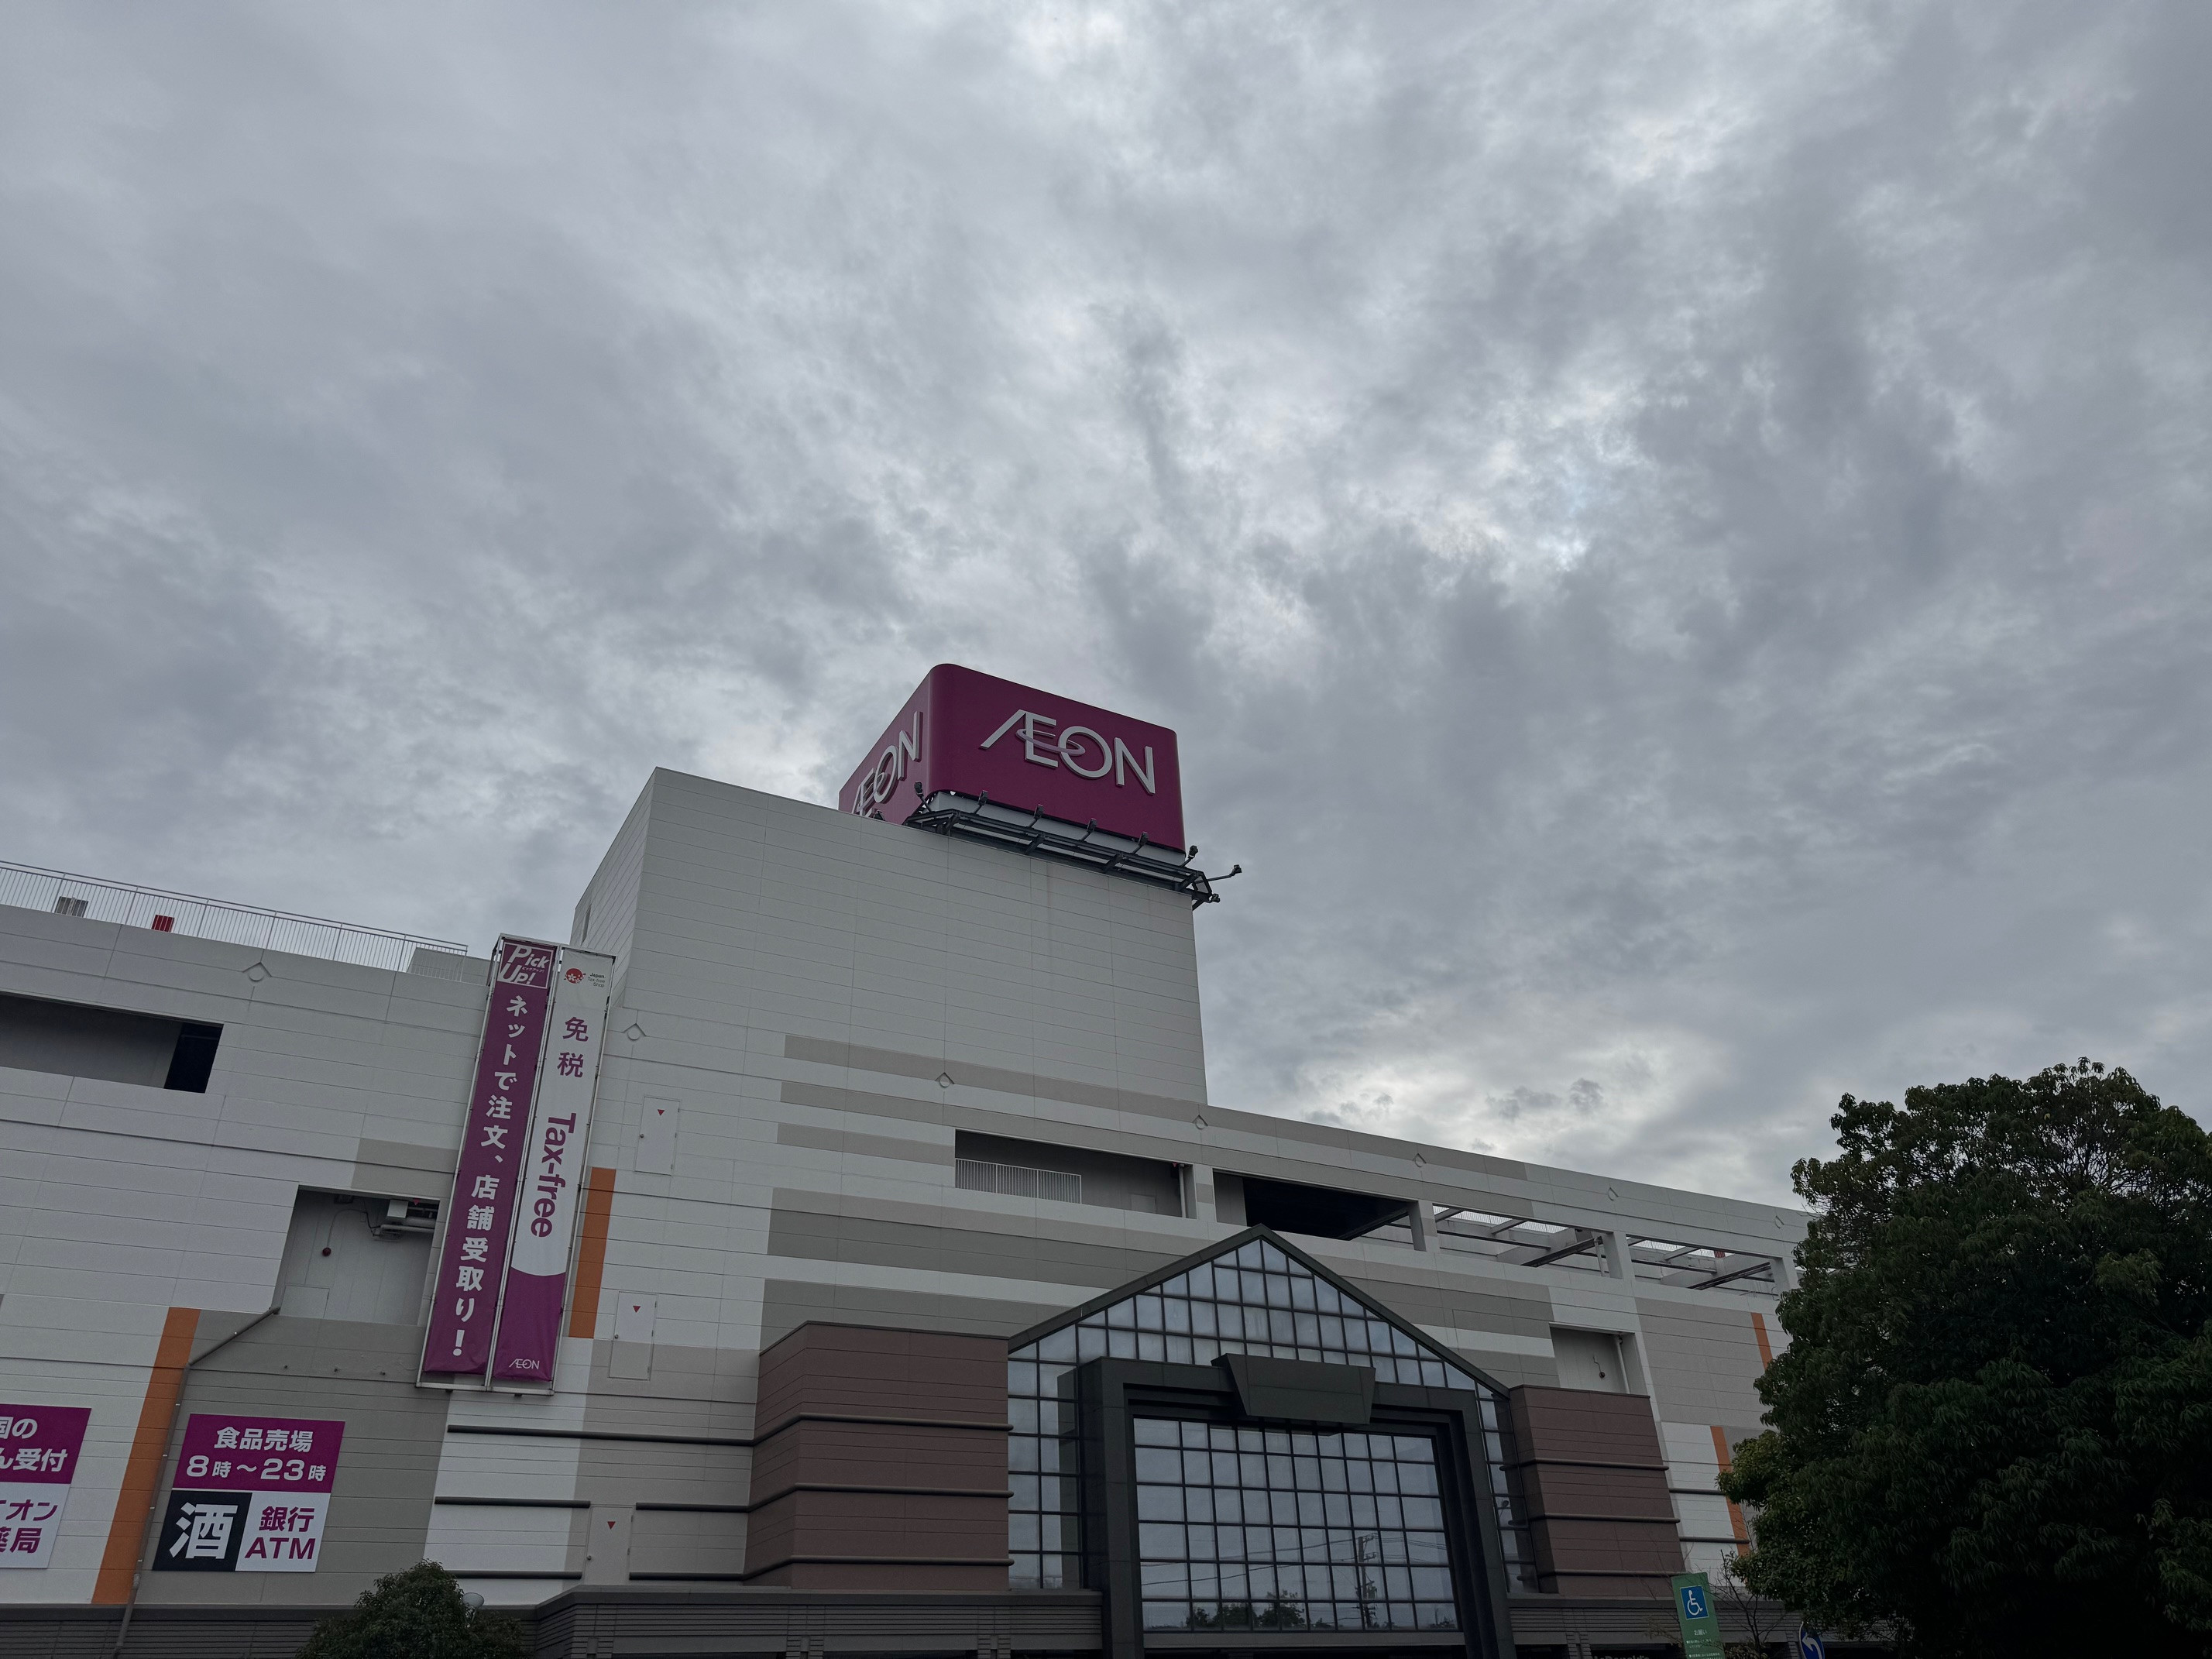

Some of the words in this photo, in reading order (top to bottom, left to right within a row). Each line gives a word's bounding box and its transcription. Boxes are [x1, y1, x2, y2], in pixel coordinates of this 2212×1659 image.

[507, 945, 549, 969] Pick
[557, 1016, 589, 1077] 免税
[531, 1112, 577, 1237] Tax-free
[214, 1426, 314, 1453] 食品売場
[0, 1499, 58, 1521] オン
[259, 1506, 315, 1532] 銀行
[169, 1502, 238, 1560] 酒
[245, 1537, 316, 1560] ATM
